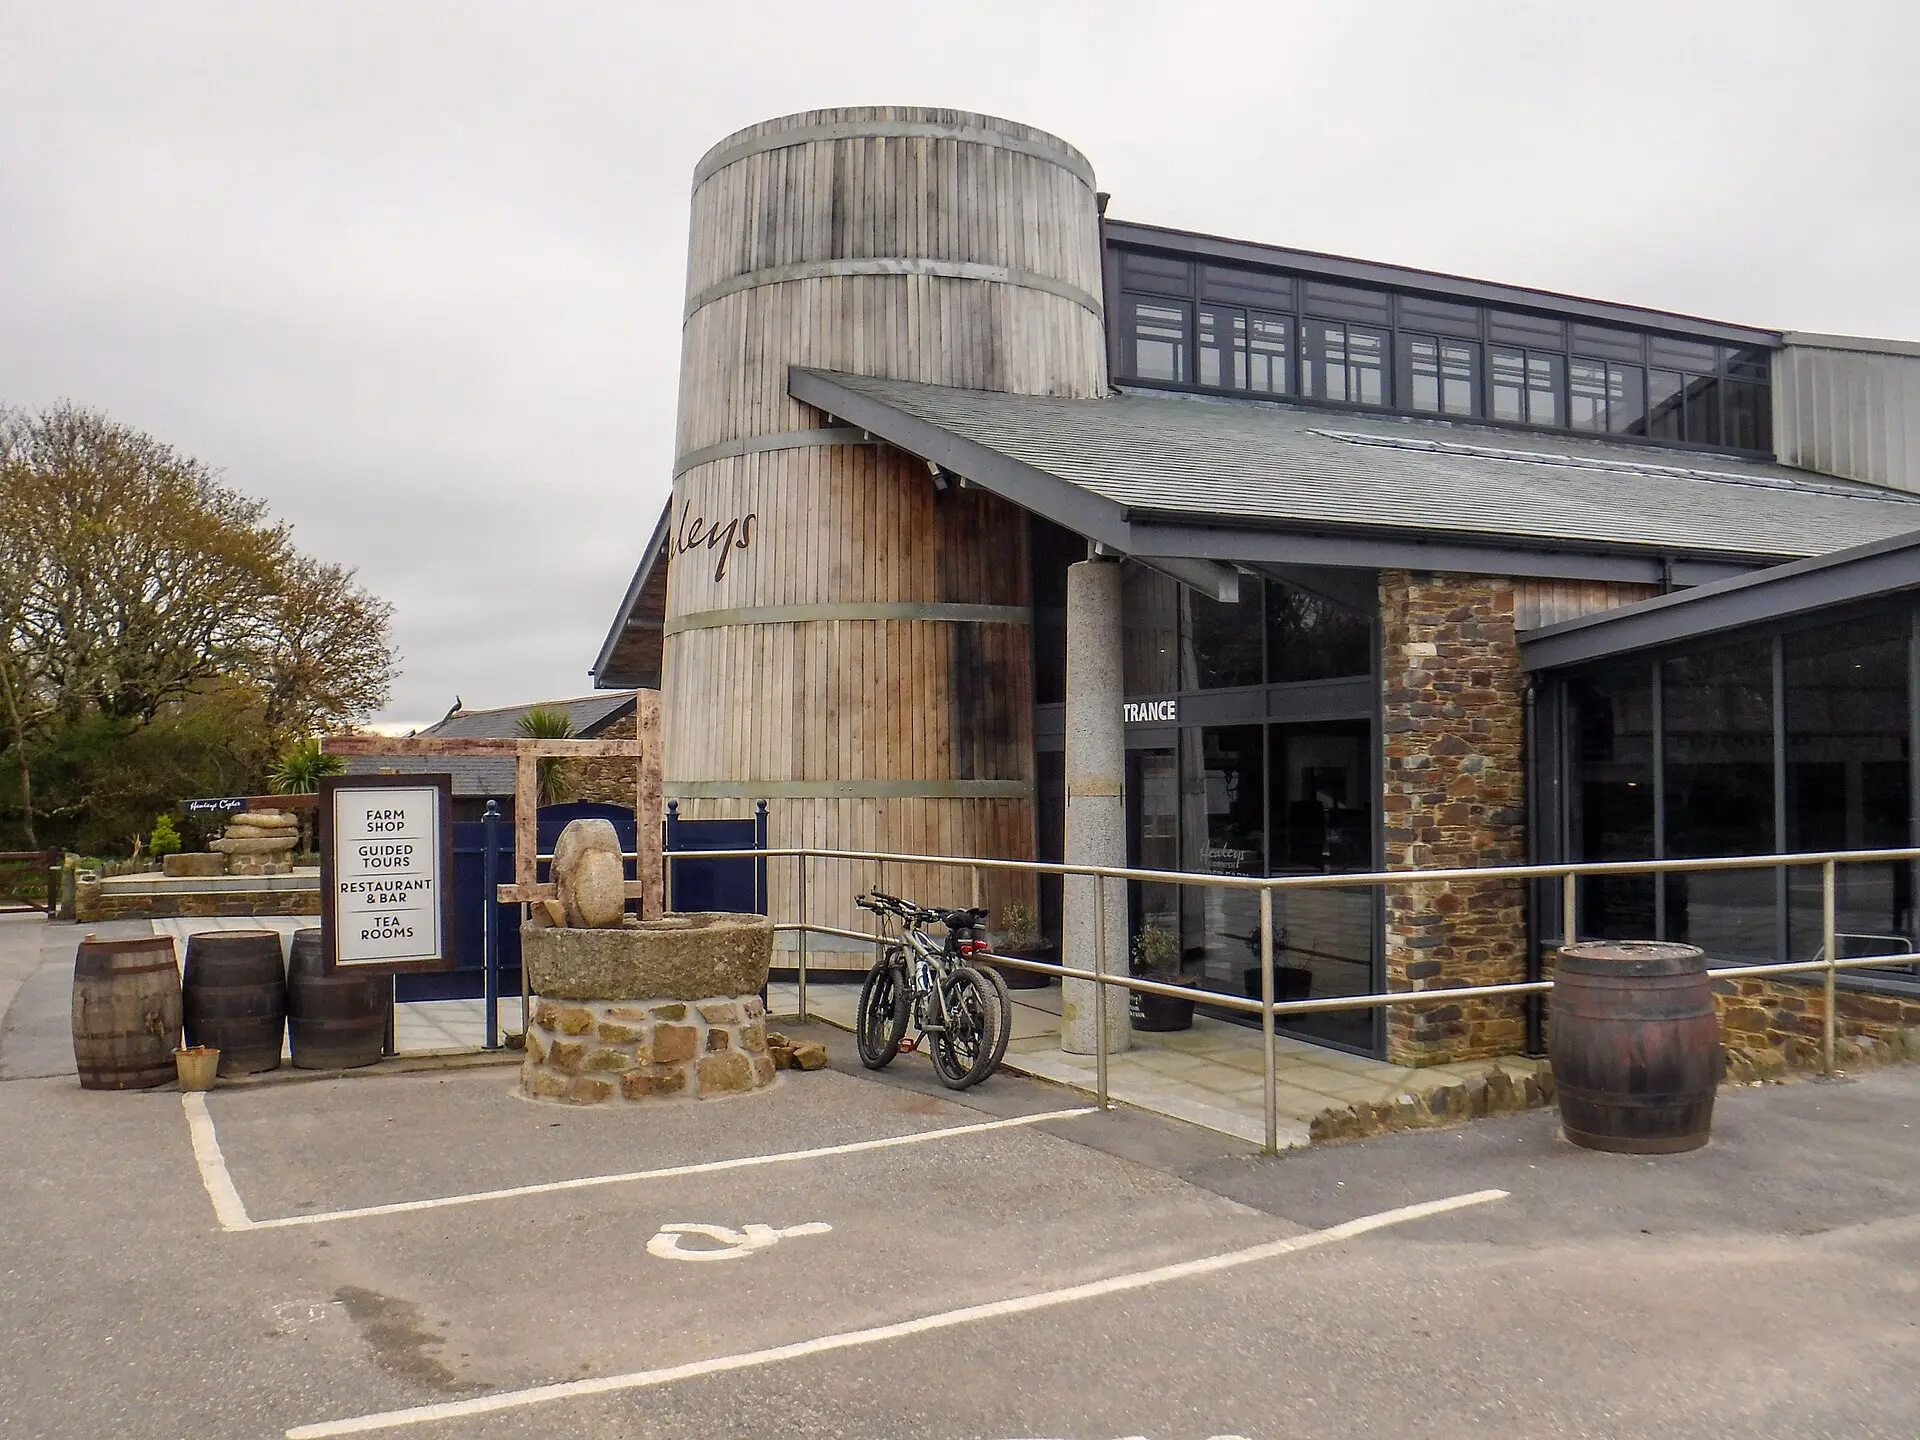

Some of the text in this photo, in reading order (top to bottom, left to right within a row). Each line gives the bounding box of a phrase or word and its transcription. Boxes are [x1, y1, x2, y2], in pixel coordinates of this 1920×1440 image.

[1123, 700, 1176, 722] TRANCE
[367, 810, 405, 821] FARM
[367, 821, 405, 833] SHOP
[358, 845, 413, 857] GUIDED
[362, 857, 410, 868] TOURS
[340, 879, 432, 893] RESTAURANT
[366, 892, 407, 904] & BAR
[374, 916, 401, 927] TEA
[361, 927, 414, 940] ROOMS
